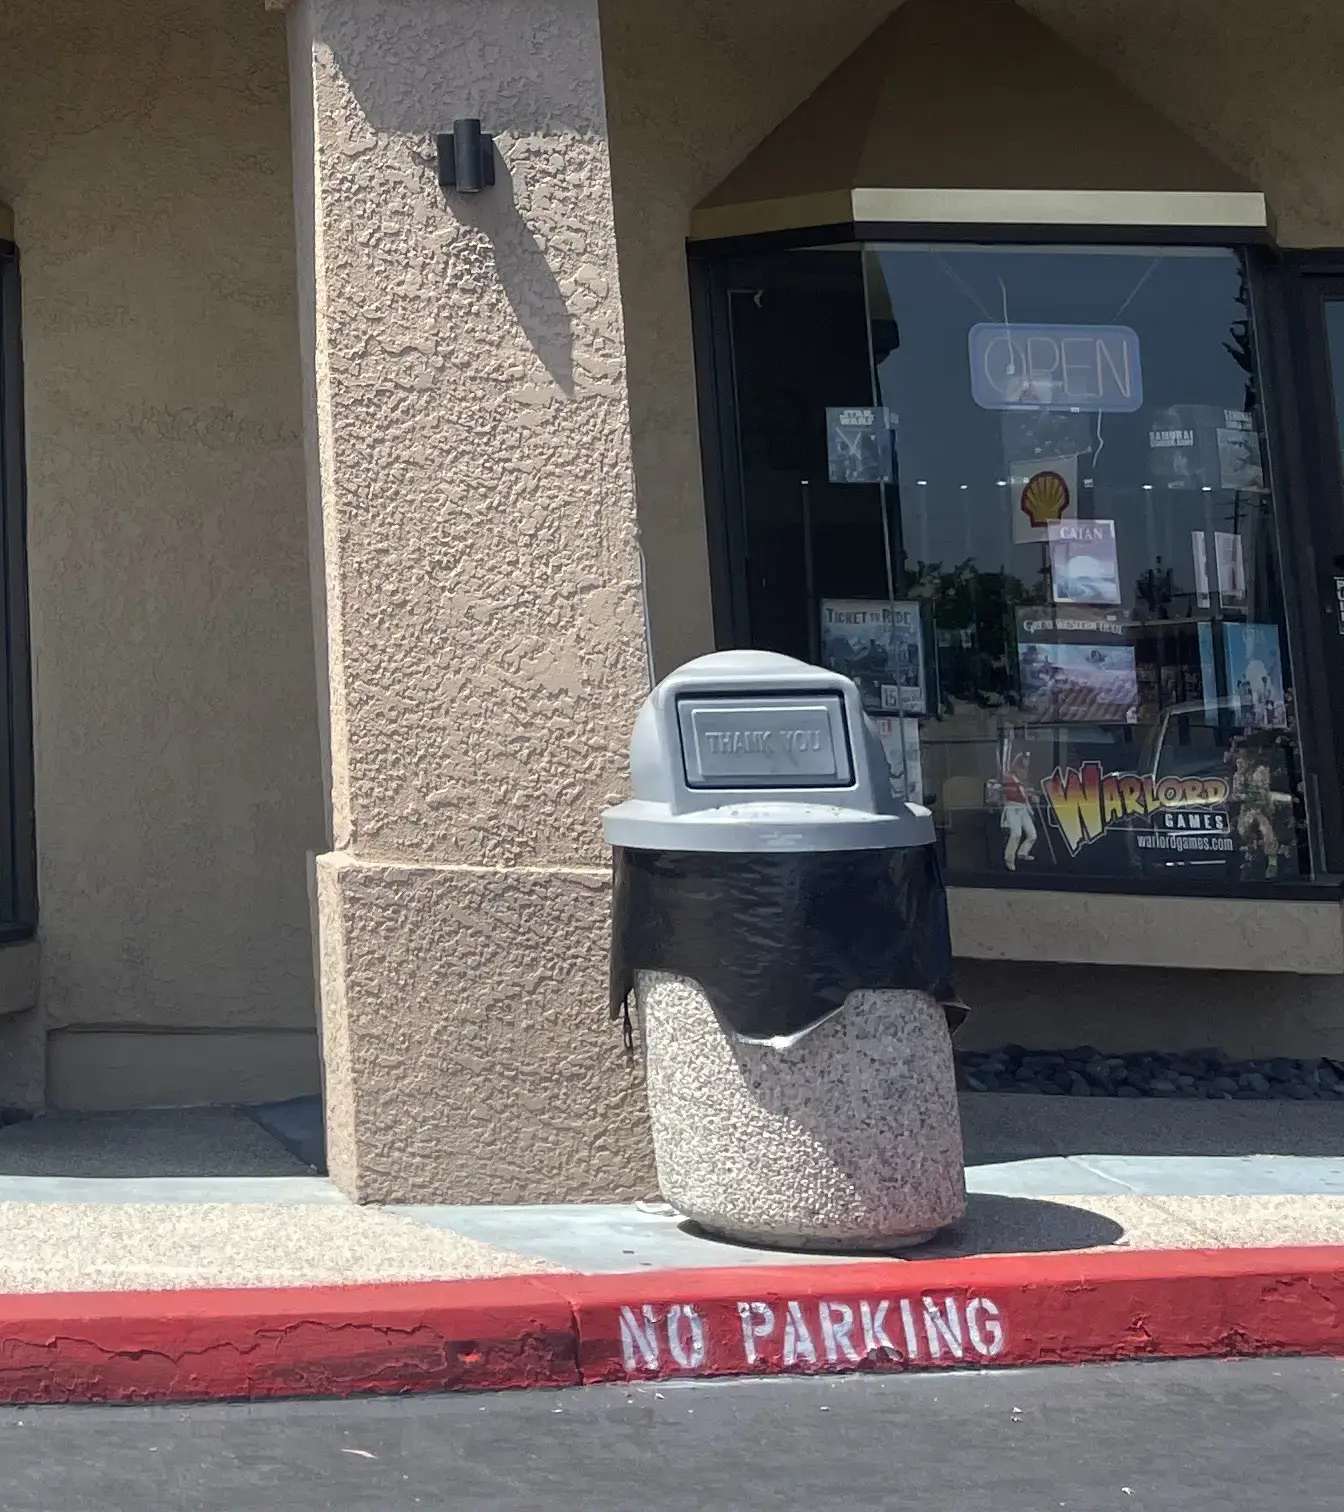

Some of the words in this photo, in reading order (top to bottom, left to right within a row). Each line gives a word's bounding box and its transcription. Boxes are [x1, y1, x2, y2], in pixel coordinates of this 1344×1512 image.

[984, 336, 1131, 398] OPEN
[704, 730, 774, 755] THANK
[779, 729, 822, 754] YOU
[1042, 762, 1229, 855] WARLORD
[1164, 814, 1224, 830] GAMES
[1136, 834, 1234, 852] warlordgames.com
[618, 1302, 708, 1372] NO
[736, 1295, 1006, 1367] PARKING
